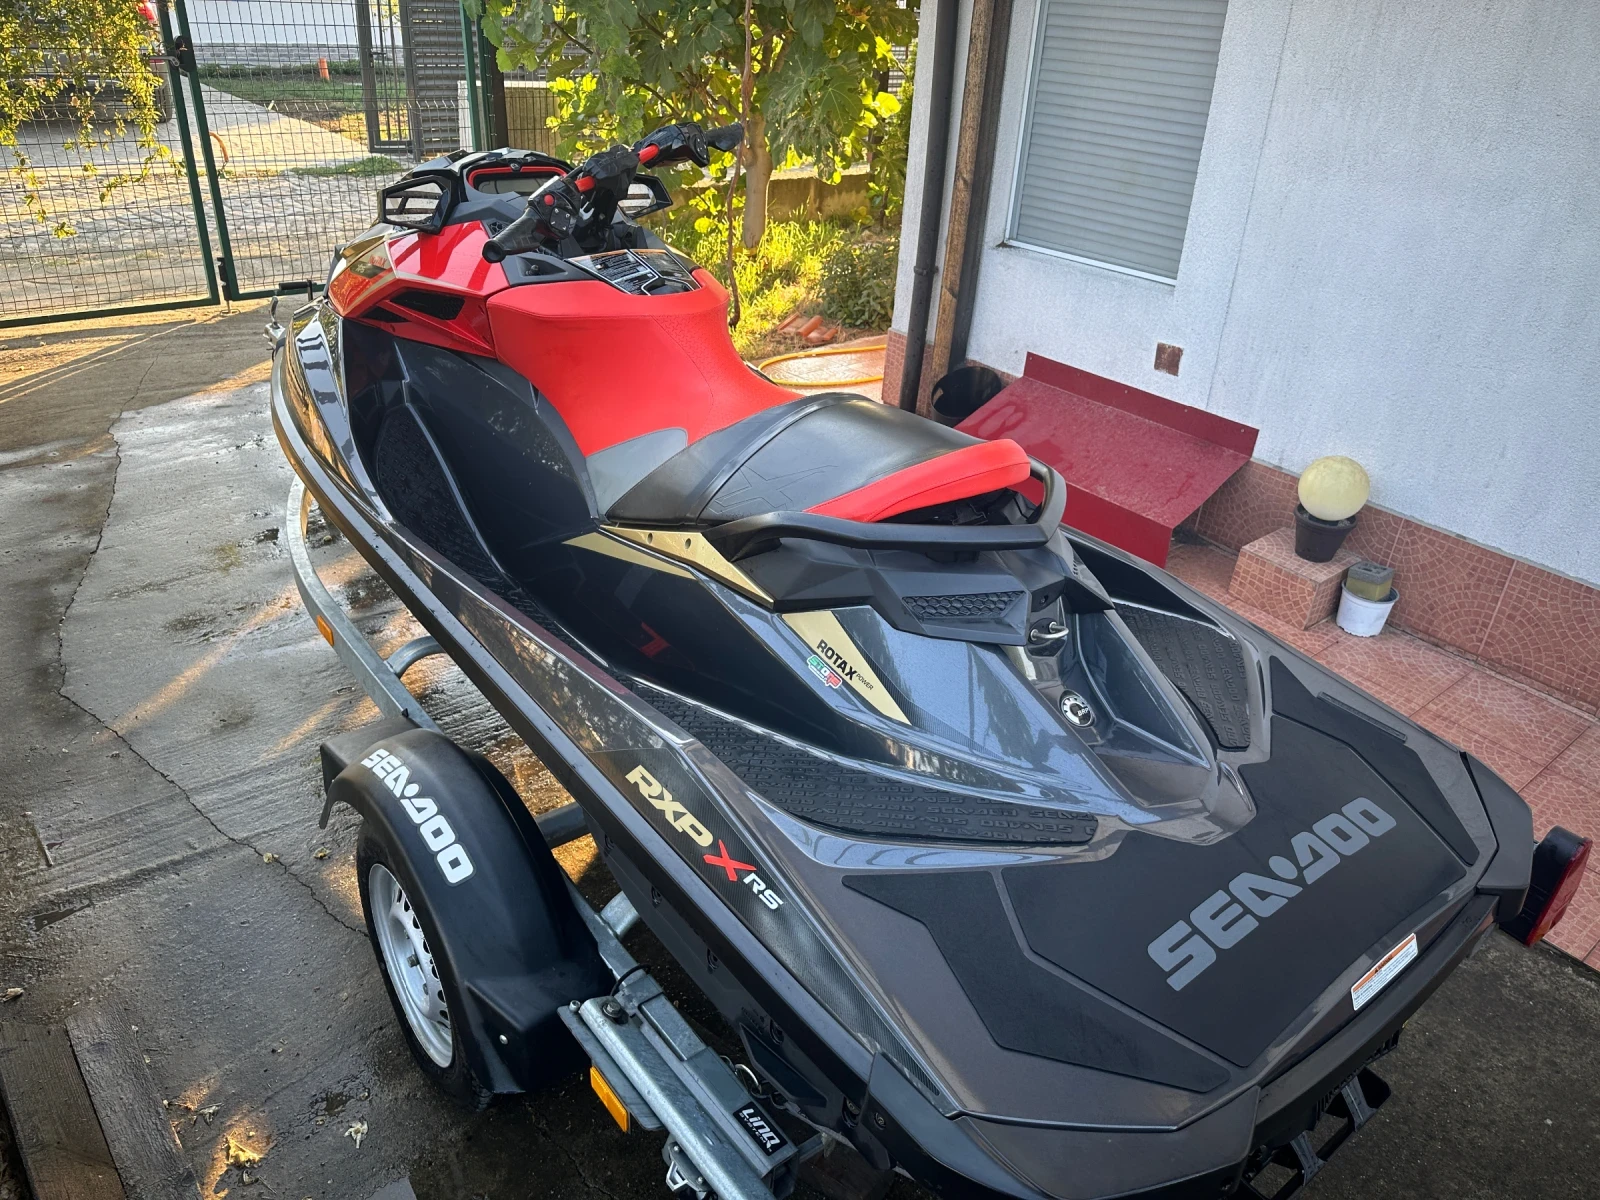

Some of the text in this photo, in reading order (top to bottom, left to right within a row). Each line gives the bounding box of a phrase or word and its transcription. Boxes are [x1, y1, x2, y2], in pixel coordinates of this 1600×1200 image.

[816, 639, 857, 681] ROTAX
[856, 673, 874, 691] POWER
[1077, 707, 1089, 717] BRP
[624, 764, 785, 911] RXP X RS
[738, 1112, 766, 1143] SYSTEM
